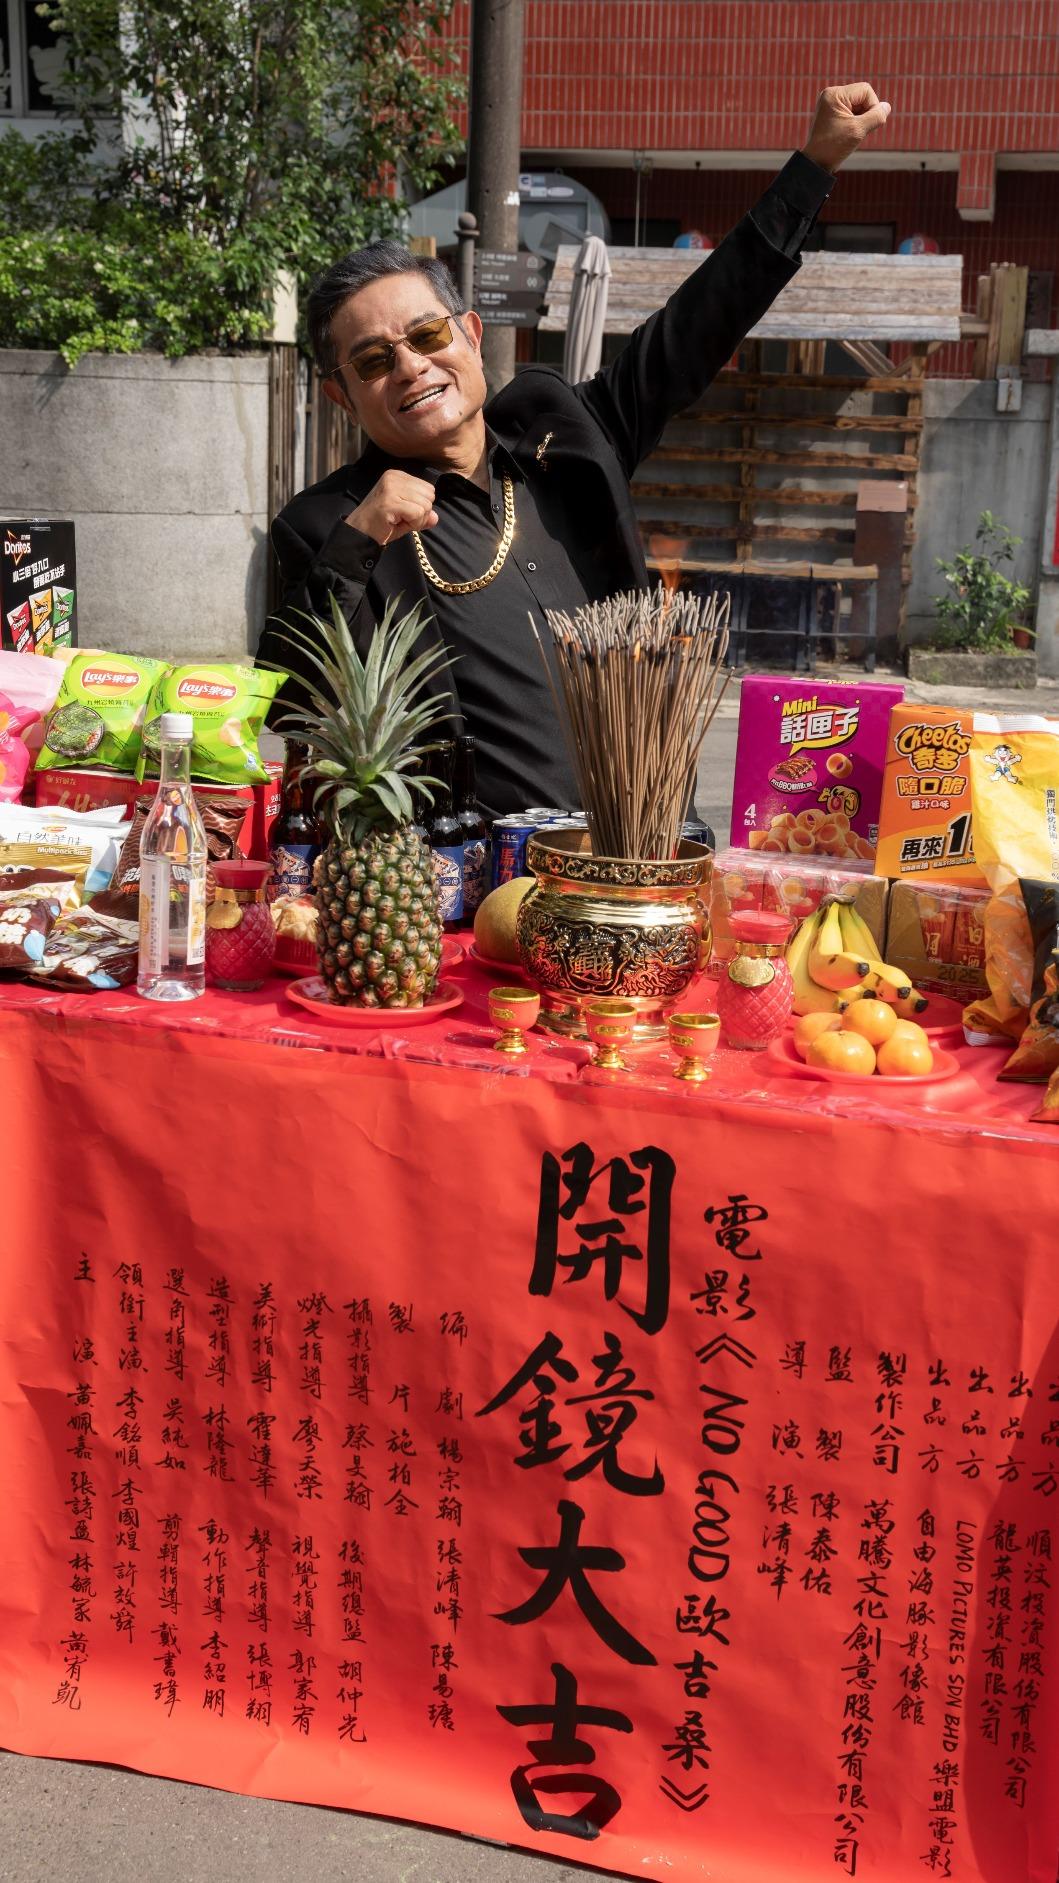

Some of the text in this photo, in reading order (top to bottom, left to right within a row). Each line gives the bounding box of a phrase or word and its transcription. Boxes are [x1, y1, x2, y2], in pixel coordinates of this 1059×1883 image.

[4, 541, 31, 554] Doritos
[84, 671, 112, 685] Lay's
[180, 681, 210, 695] Lay's
[782, 696, 818, 716] Mini
[780, 707, 860, 744] 話匣子
[896, 722, 972, 756] Cheetos
[913, 748, 959, 770] 奇多
[897, 776, 967, 796] 隨口脆
[744, 804, 756, 818] 4
[918, 1359, 950, 1473] 出品方
[956, 1366, 993, 1479] 出品方
[996, 1372, 1034, 1482] 出品方
[474, 1141, 676, 1842] 開鏡大吉
[955, 1521, 976, 1572] LOMO
[949, 1580, 973, 1664] PICTURES
[946, 1675, 964, 1707] SDN
[943, 1714, 960, 1752] BHD
